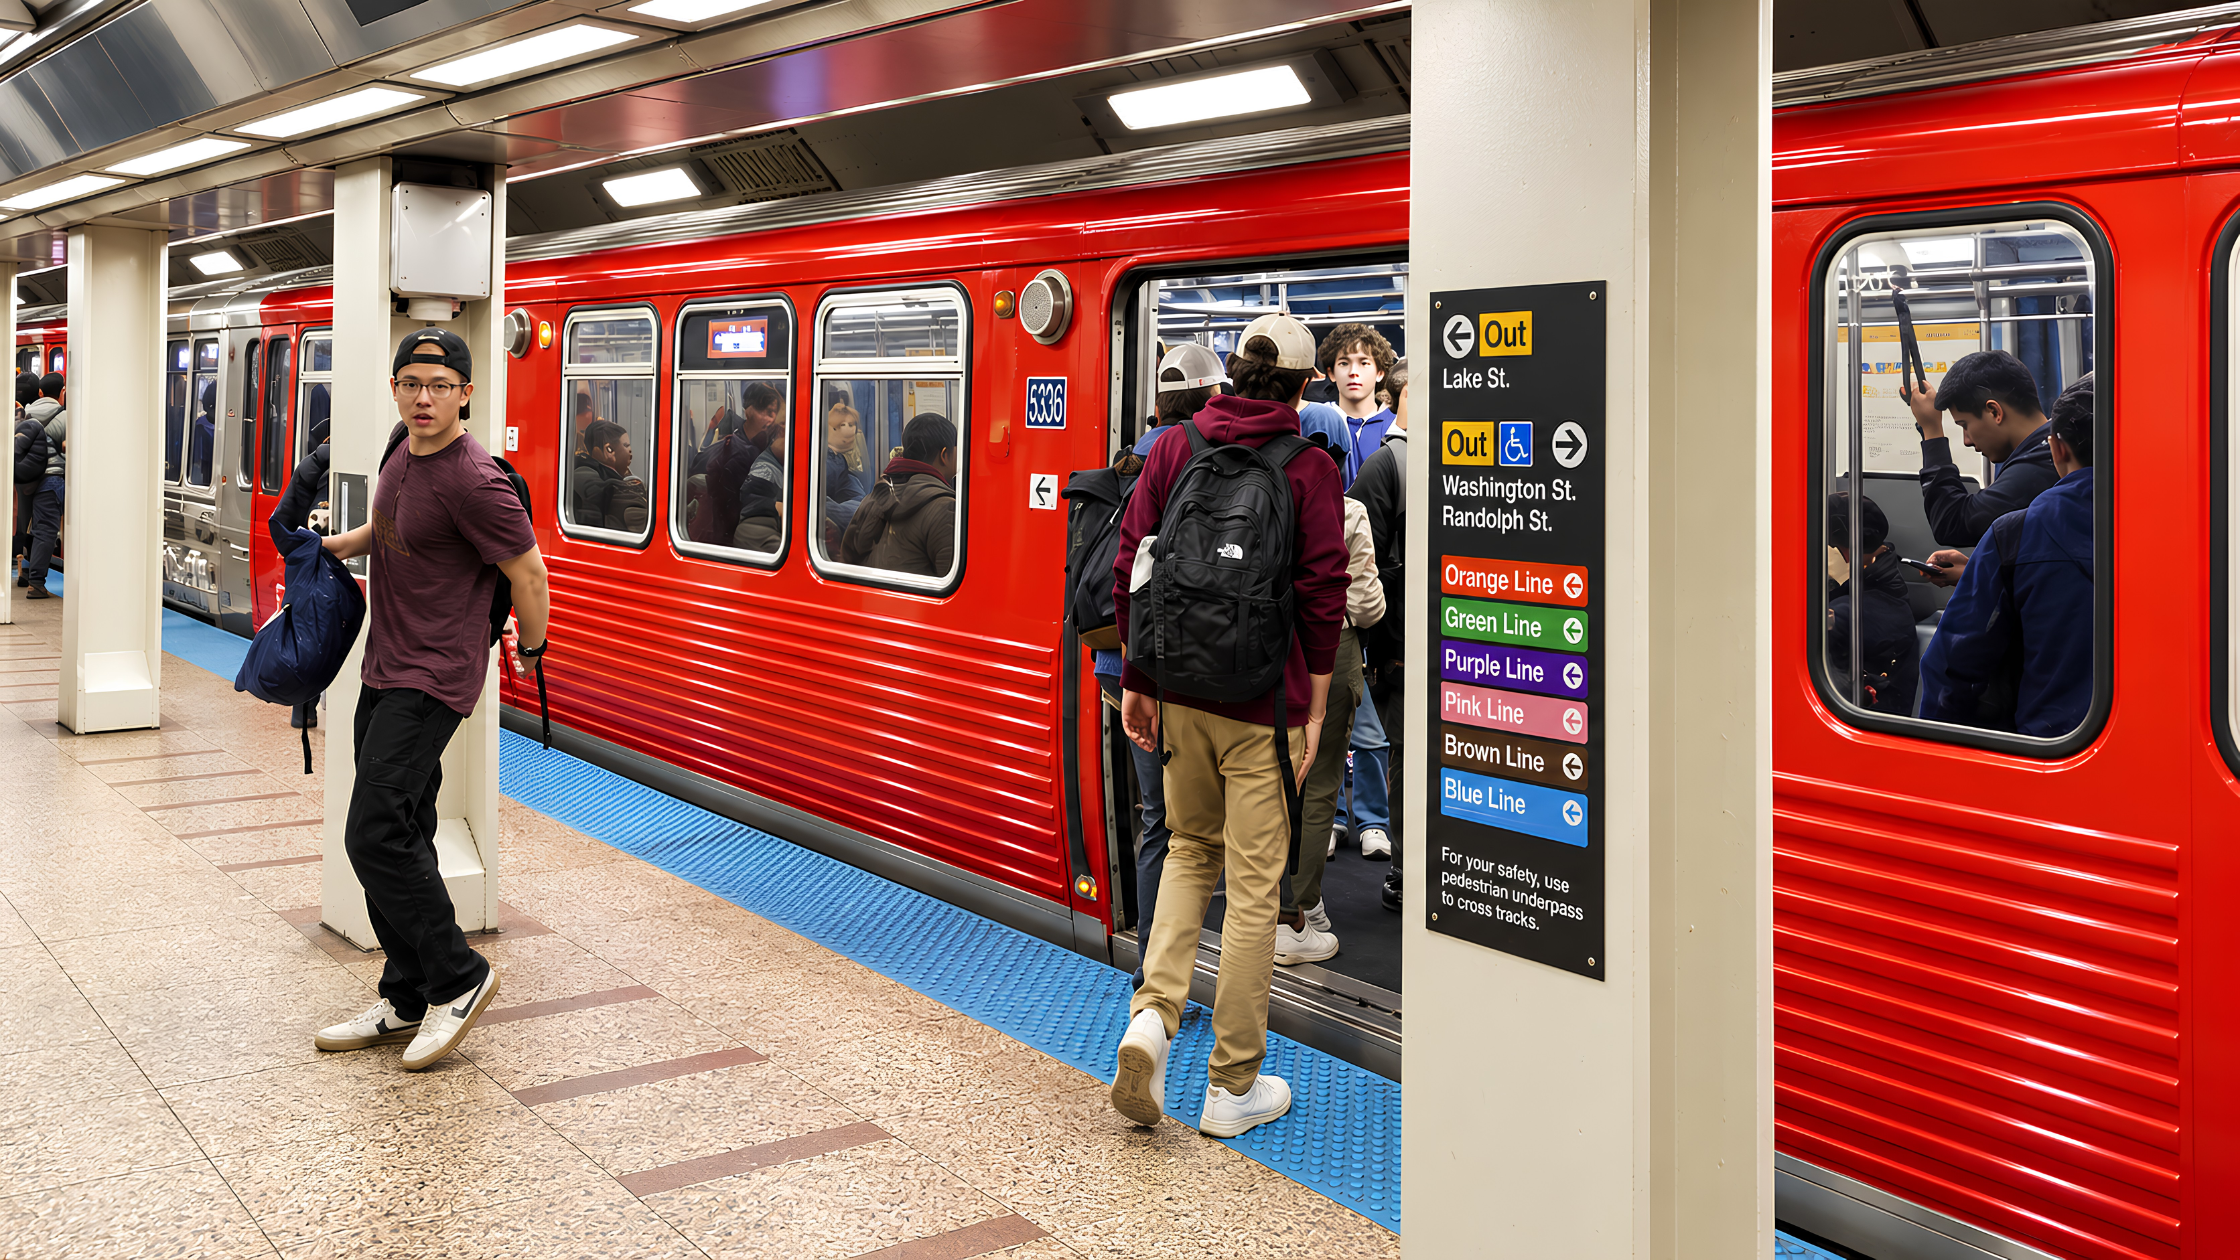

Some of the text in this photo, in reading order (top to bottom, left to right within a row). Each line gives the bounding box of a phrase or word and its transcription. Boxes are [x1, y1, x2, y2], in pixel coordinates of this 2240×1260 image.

[1484, 320, 1527, 348] Out
[1443, 367, 1510, 389] Lake St.
[1029, 383, 1063, 423] 5336
[1447, 428, 1488, 457] Out
[1443, 474, 1576, 504] Washington St.
[1443, 505, 1553, 534] Randolph St.
[1445, 563, 1554, 595] Orange Line
[1445, 606, 1542, 638] Green Line
[1445, 648, 1544, 682] Purple Line
[1445, 691, 1524, 725] Pink Line
[1445, 733, 1545, 772] Brown Line
[1445, 777, 1526, 814] Blue Line
[1442, 846, 1570, 893] For your safety, use
[1441, 871, 1584, 921] pedestrian underpass
[1441, 890, 1540, 930] to cross tracks.
